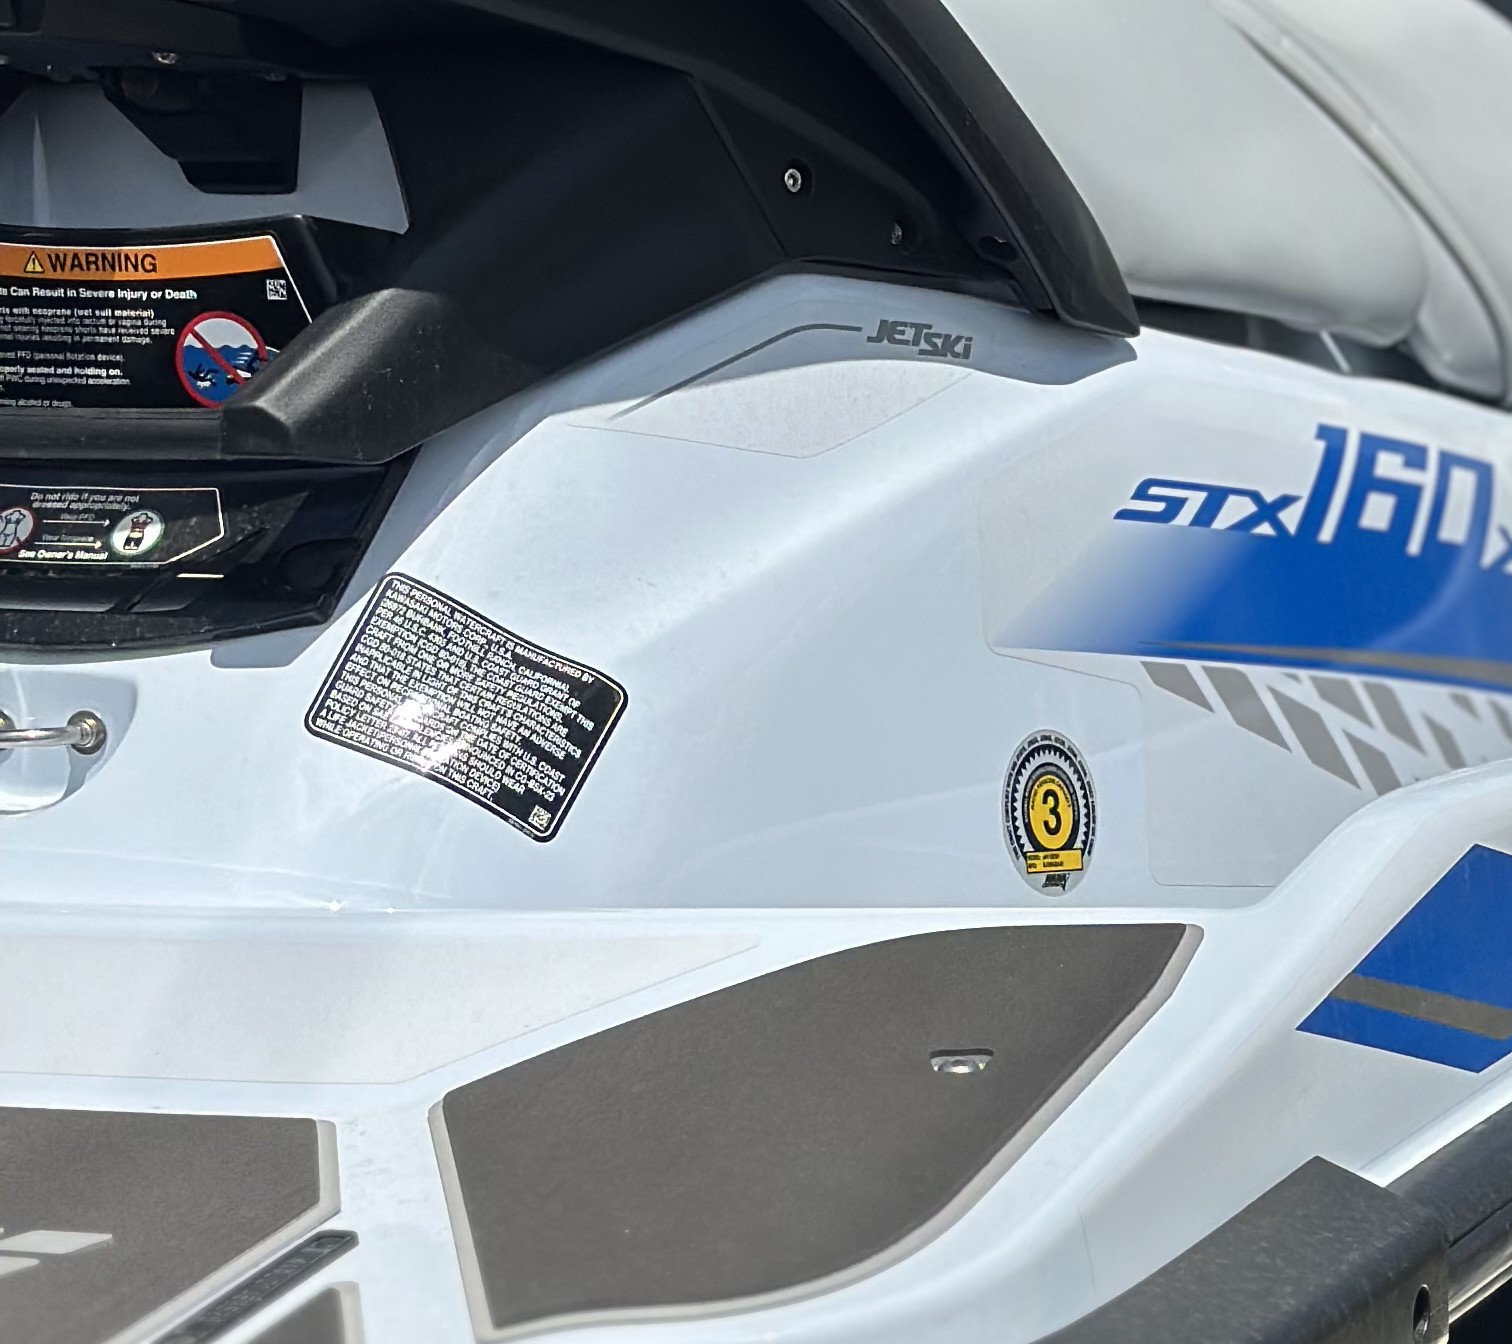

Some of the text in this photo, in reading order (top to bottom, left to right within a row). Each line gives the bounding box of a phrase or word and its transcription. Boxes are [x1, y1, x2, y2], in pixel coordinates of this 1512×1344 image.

[10, 287, 30, 297] Can
[32, 287, 64, 298] Result
[67, 288, 77, 298] in
[79, 288, 115, 299] Severe
[117, 288, 148, 301] Injury
[150, 291, 162, 299] or
[165, 289, 197, 300] Death
[48, 253, 158, 273] WARNING
[114, 308, 155, 319] material)
[56, 367, 72, 375] and
[74, 367, 107, 377] holding
[31, 492, 43, 500] Do
[62, 493, 79, 501] ride
[89, 494, 106, 503] you
[124, 494, 139, 503] not
[18, 549, 108, 560] See Owner's Manual
[385, 588, 429, 614] KAWASAKI
[427, 608, 463, 633] MOTORS
[390, 579, 595, 684] THIS PERSONAL WATERCRAFT IS MANUFACTURED BY
[446, 630, 487, 657] FOOTHILL
[359, 633, 380, 648] CGD
[405, 654, 437, 675] STATES
[436, 670, 460, 686] THAT
[458, 679, 496, 701] CERTAIN
[495, 693, 552, 727] REGULATIONS
[550, 721, 568, 738] ARE
[365, 624, 394, 643] CRAFT
[392, 636, 419, 654] FROM
[416, 648, 437, 664] ONE
[435, 658, 450, 670] OR
[448, 664, 475, 683] MORE
[474, 676, 507, 695] SAFETY
[369, 615, 418, 643] EXEMPTION
[468, 664, 487, 677] THE
[485, 671, 515, 689] COAST
[513, 682, 545, 701] GUARD
[544, 695, 577, 718] EXEMPT
[575, 713, 594, 731] THIS
[374, 606, 393, 620] PER
[445, 641, 465, 656] AND
[480, 659, 510, 678] COAST
[509, 671, 540, 690] GUARD
[538, 683, 569, 702] GRANT
[566, 697, 581, 710] OF
[319, 707, 328, 717] A
[326, 710, 347, 724] LIFE
[339, 670, 360, 685] THIS
[459, 720, 502, 745] COMPLIES
[501, 739, 524, 757] WITH
[537, 760, 565, 783] COAST
[344, 661, 377, 681] EFFECT
[375, 674, 391, 687] ON
[452, 707, 490, 728] BOATING
[349, 652, 566, 761] AND THAT THE EXEMPTION WILL NOT HAVE AN ADVERSE
[354, 642, 413, 675] INAPPLICABLE
[411, 668, 423, 679] IN
[421, 673, 447, 691] LIGHT
[445, 684, 459, 696] OF
[459, 690, 479, 704] THIS
[512, 711, 582, 758] CHARACTERISTICS
[314, 717, 342, 734] WHILE
[341, 728, 389, 752] OPERATING
[389, 745, 404, 756] OR
[447, 768, 467, 783] THIS
[324, 698, 357, 717] POLICY
[355, 711, 387, 730] LETTER
[467, 755, 502, 780] SHOULD
[500, 774, 525, 795] WEAR
[329, 689, 515, 777] BASED ON IN
[334, 679, 365, 699] GUARD
[475, 737, 499, 755] DATE
[497, 748, 511, 761] OF
[509, 755, 565, 796] CERTIFICATION
[1042, 788, 1062, 836] 3
